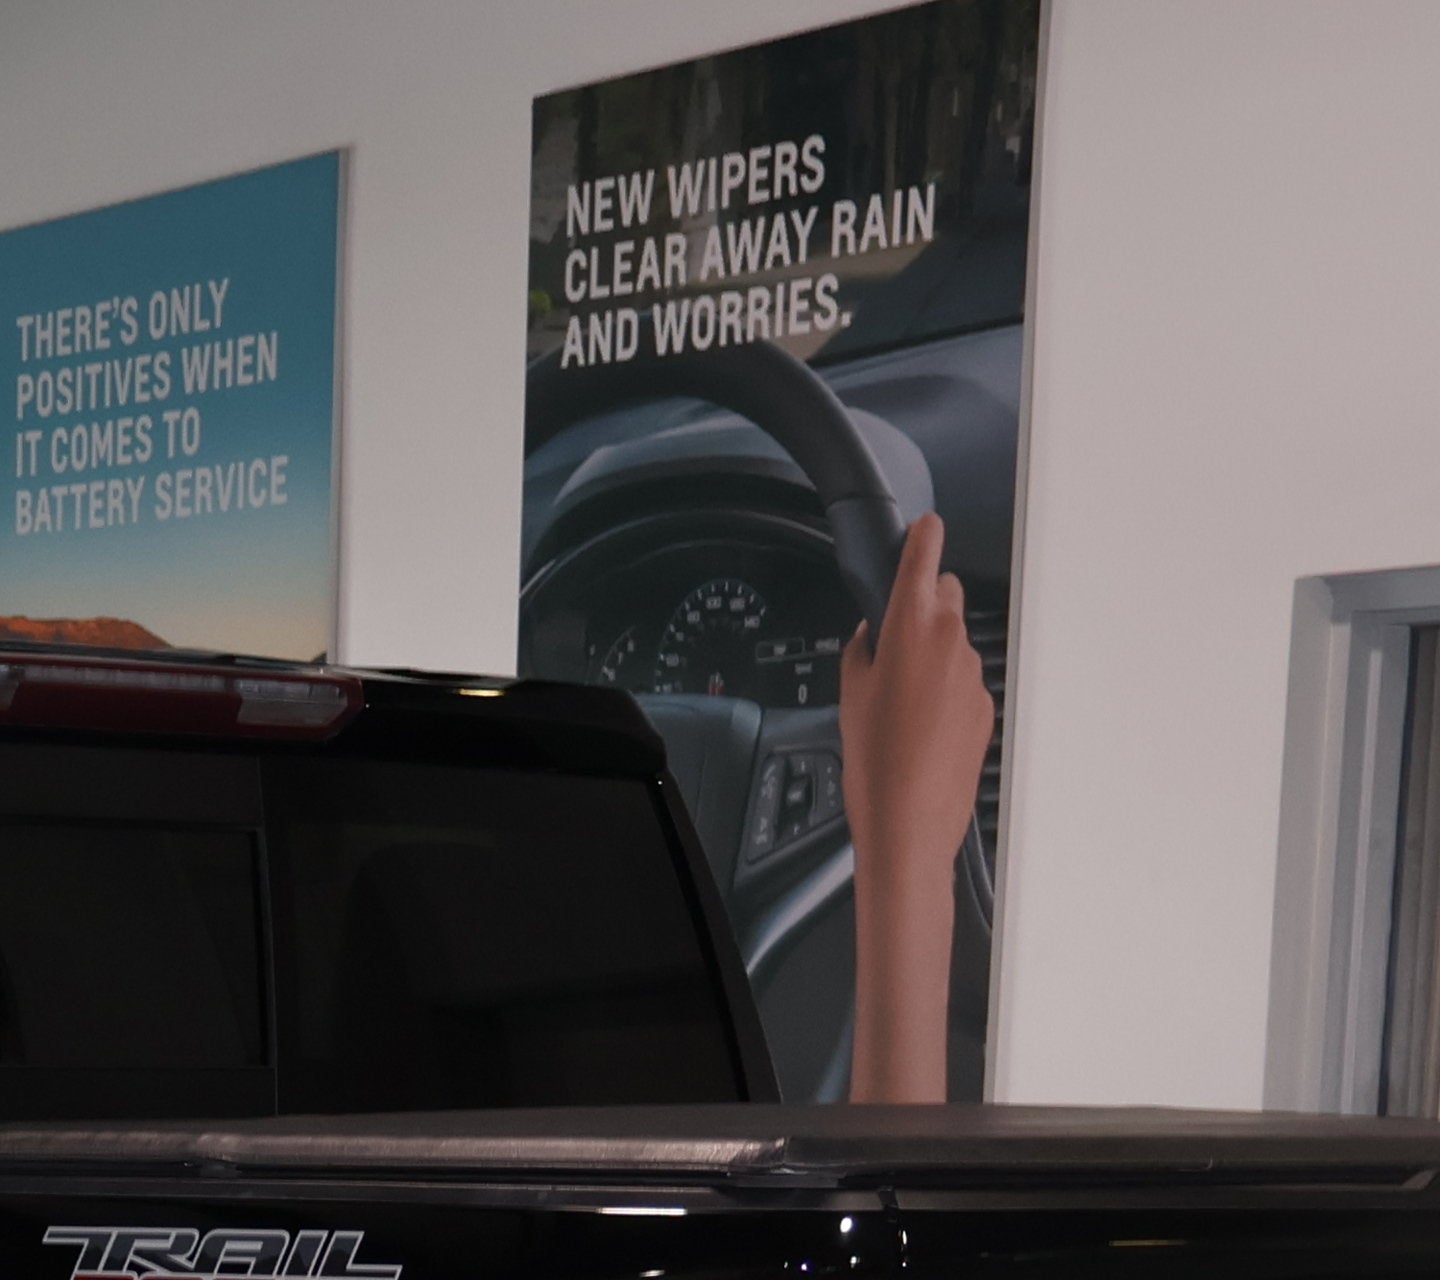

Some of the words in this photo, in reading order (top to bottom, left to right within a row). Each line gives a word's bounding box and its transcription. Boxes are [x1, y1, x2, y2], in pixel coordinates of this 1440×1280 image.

[566, 168, 656, 240] NEW
[667, 133, 827, 220] WIPERS
[564, 231, 688, 303] CLEAR
[700, 206, 820, 283] AWAY
[830, 181, 937, 259] RAIN
[16, 295, 140, 363] THERE'S
[148, 277, 230, 341] ONLY
[560, 308, 639, 370] AND
[652, 272, 852, 358] WORRIES.
[16, 350, 172, 421] POSITIVES
[181, 329, 279, 395] WHEN
[16, 429, 43, 479] IT
[50, 413, 154, 474] COMES
[162, 405, 202, 459] TO
[15, 475, 146, 536] BATTERY
[154, 454, 289, 521] SERVICE
